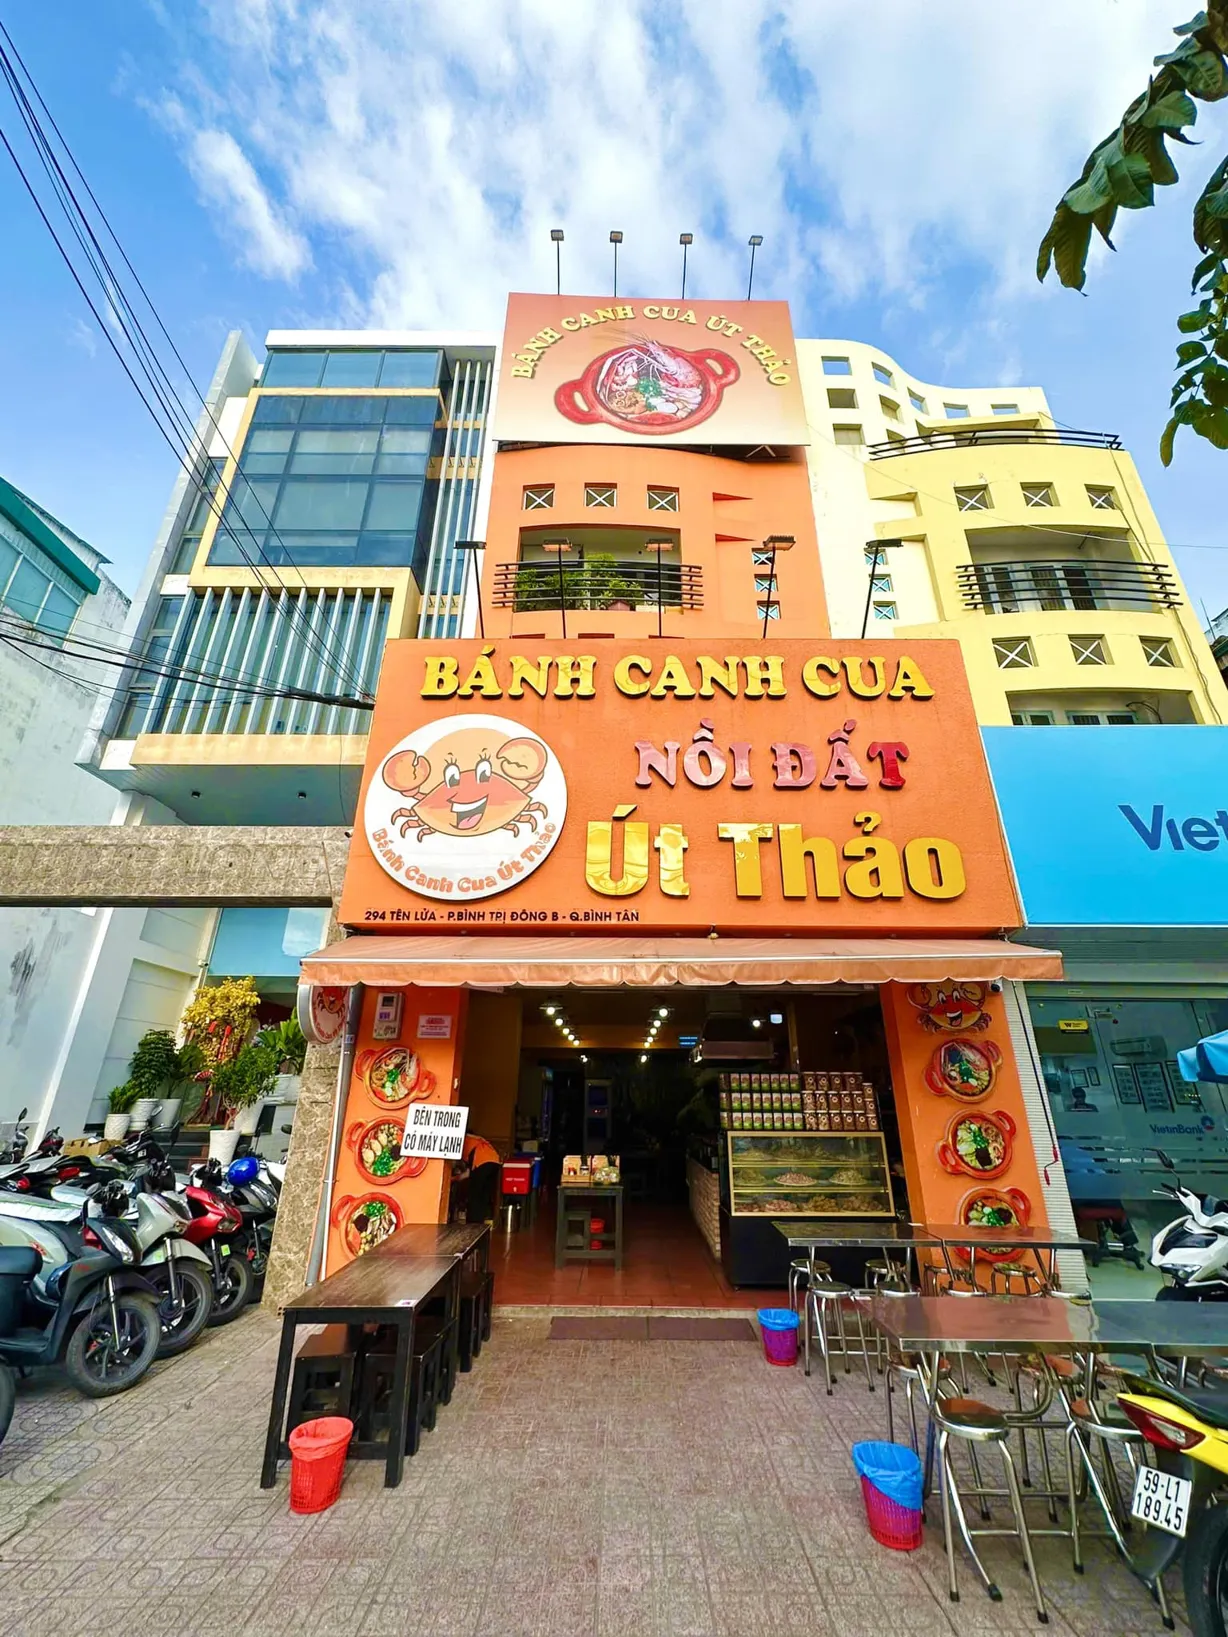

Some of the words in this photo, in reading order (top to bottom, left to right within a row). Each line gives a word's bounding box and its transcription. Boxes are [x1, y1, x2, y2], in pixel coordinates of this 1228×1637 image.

[511, 327, 563, 379] BÁNH
[561, 305, 636, 332] CANH
[643, 305, 697, 324] CUA
[706, 314, 743, 337] ÚT
[740, 334, 791, 385] THẢO
[420, 645, 597, 699] BÁNH
[613, 655, 788, 699] CANH
[802, 655, 935, 700] CUA
[634, 717, 754, 789] NỒI
[770, 719, 910, 790] ĐẤT
[372, 828, 405, 873] Bánh
[405, 866, 454, 893] Canh
[457, 876, 498, 893] Cua
[497, 860, 525, 881] Út
[520, 823, 556, 862] Thảo
[584, 804, 690, 898] Út
[717, 811, 967, 901] Thảo
[364, 910, 386, 921] 294
[390, 908, 411, 921] TÊN
[415, 907, 437, 921] LỬA
[448, 908, 486, 921] P.BÌNH
[510, 908, 548, 921] ĐÔNG
[552, 911, 559, 921] B
[569, 908, 612, 921] Q.BÌNH
[616, 908, 640, 921] TÂN
[413, 1105, 432, 1126] BÊN
[433, 1110, 462, 1128] TRONG
[404, 1130, 417, 1150] CÓ
[417, 1131, 438, 1152] MÁY
[439, 1135, 462, 1157] LẠNH
[1143, 1470, 1181, 1503] 59-L1
[1136, 1492, 1184, 1531] 189.45
